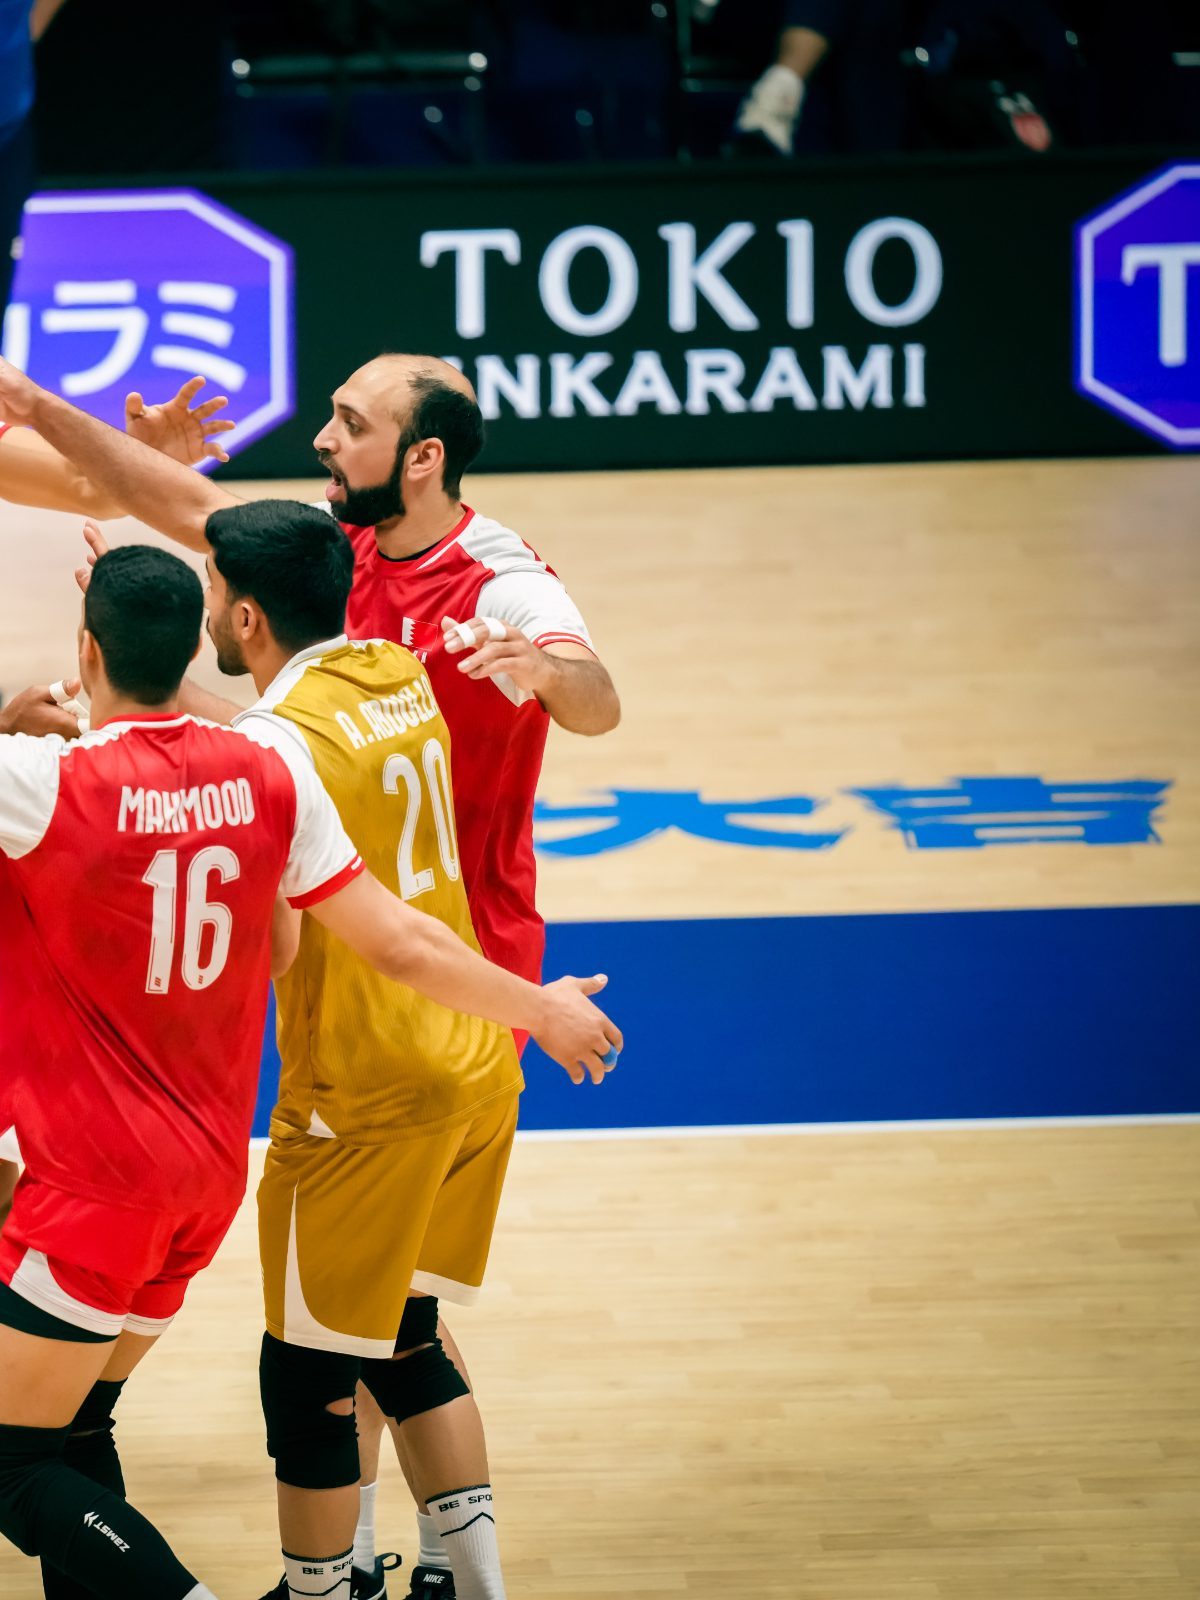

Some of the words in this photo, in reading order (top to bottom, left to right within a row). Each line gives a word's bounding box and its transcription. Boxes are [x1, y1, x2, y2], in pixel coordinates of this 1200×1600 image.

[419, 217, 943, 338] TOKIO
[442, 343, 926, 420] NKARAMI
[117, 777, 256, 834] MAHMOOD
[382, 737, 460, 901] 20
[141, 845, 240, 995] 16
[438, 1499, 460, 1513] BE
[302, 1566, 324, 1575] BE
[422, 1573, 445, 1584] NIKE
